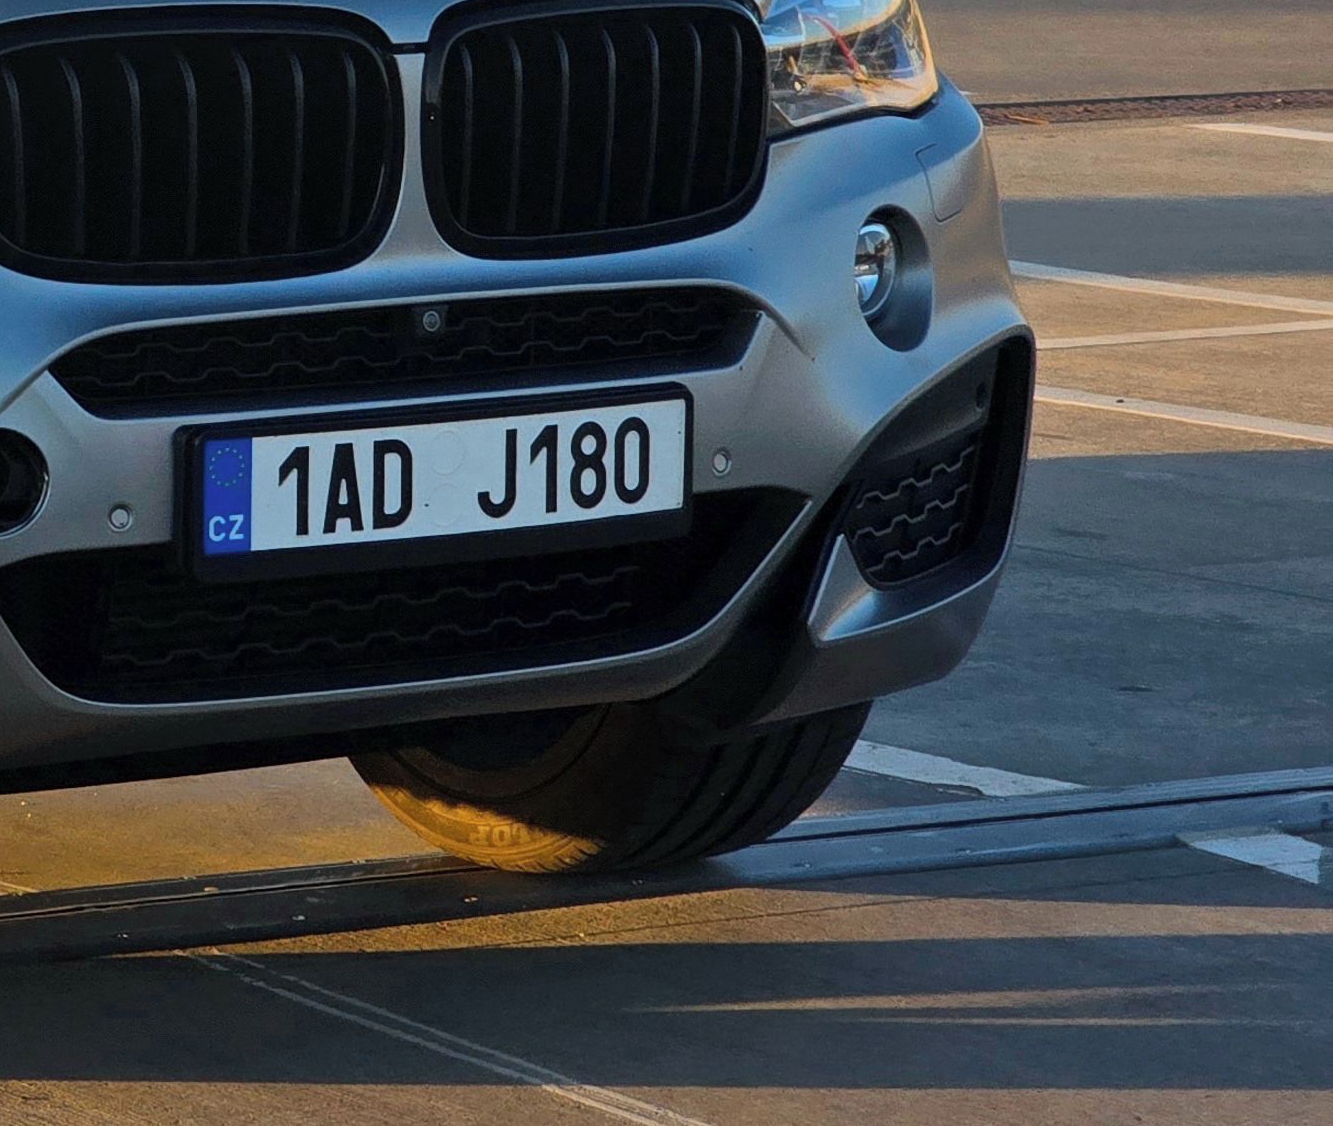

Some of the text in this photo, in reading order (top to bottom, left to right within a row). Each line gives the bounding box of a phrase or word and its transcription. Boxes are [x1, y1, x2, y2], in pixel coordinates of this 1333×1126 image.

[277, 416, 651, 537] 1AD J180
[208, 514, 245, 542] CZ
